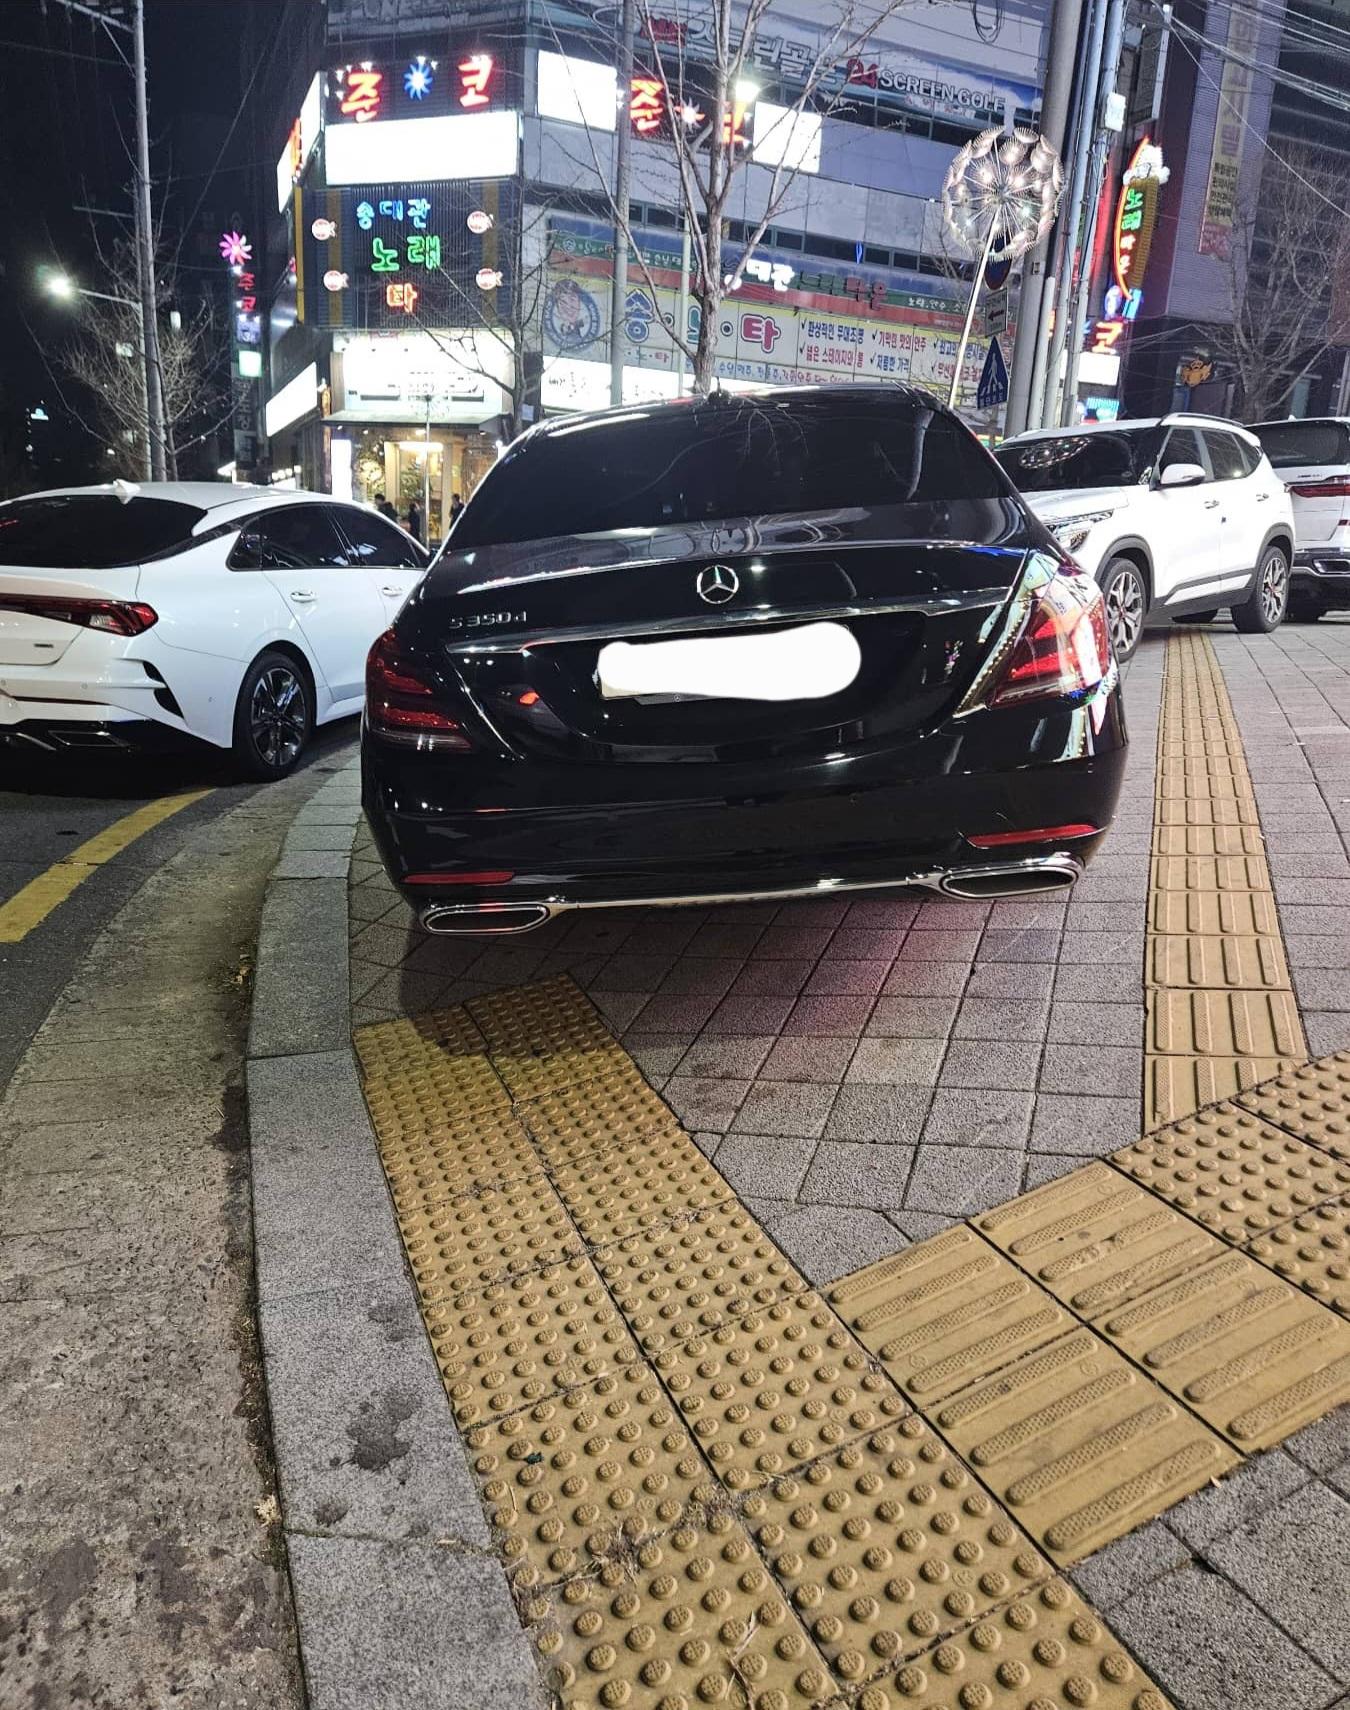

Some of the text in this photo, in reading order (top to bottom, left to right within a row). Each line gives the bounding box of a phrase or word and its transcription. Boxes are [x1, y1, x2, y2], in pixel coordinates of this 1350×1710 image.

[880, 68, 959, 103] SCREEN
[356, 198, 432, 230] 송대관
[370, 235, 441, 272] 노래
[386, 282, 418, 313] 타
[740, 313, 781, 353] 타
